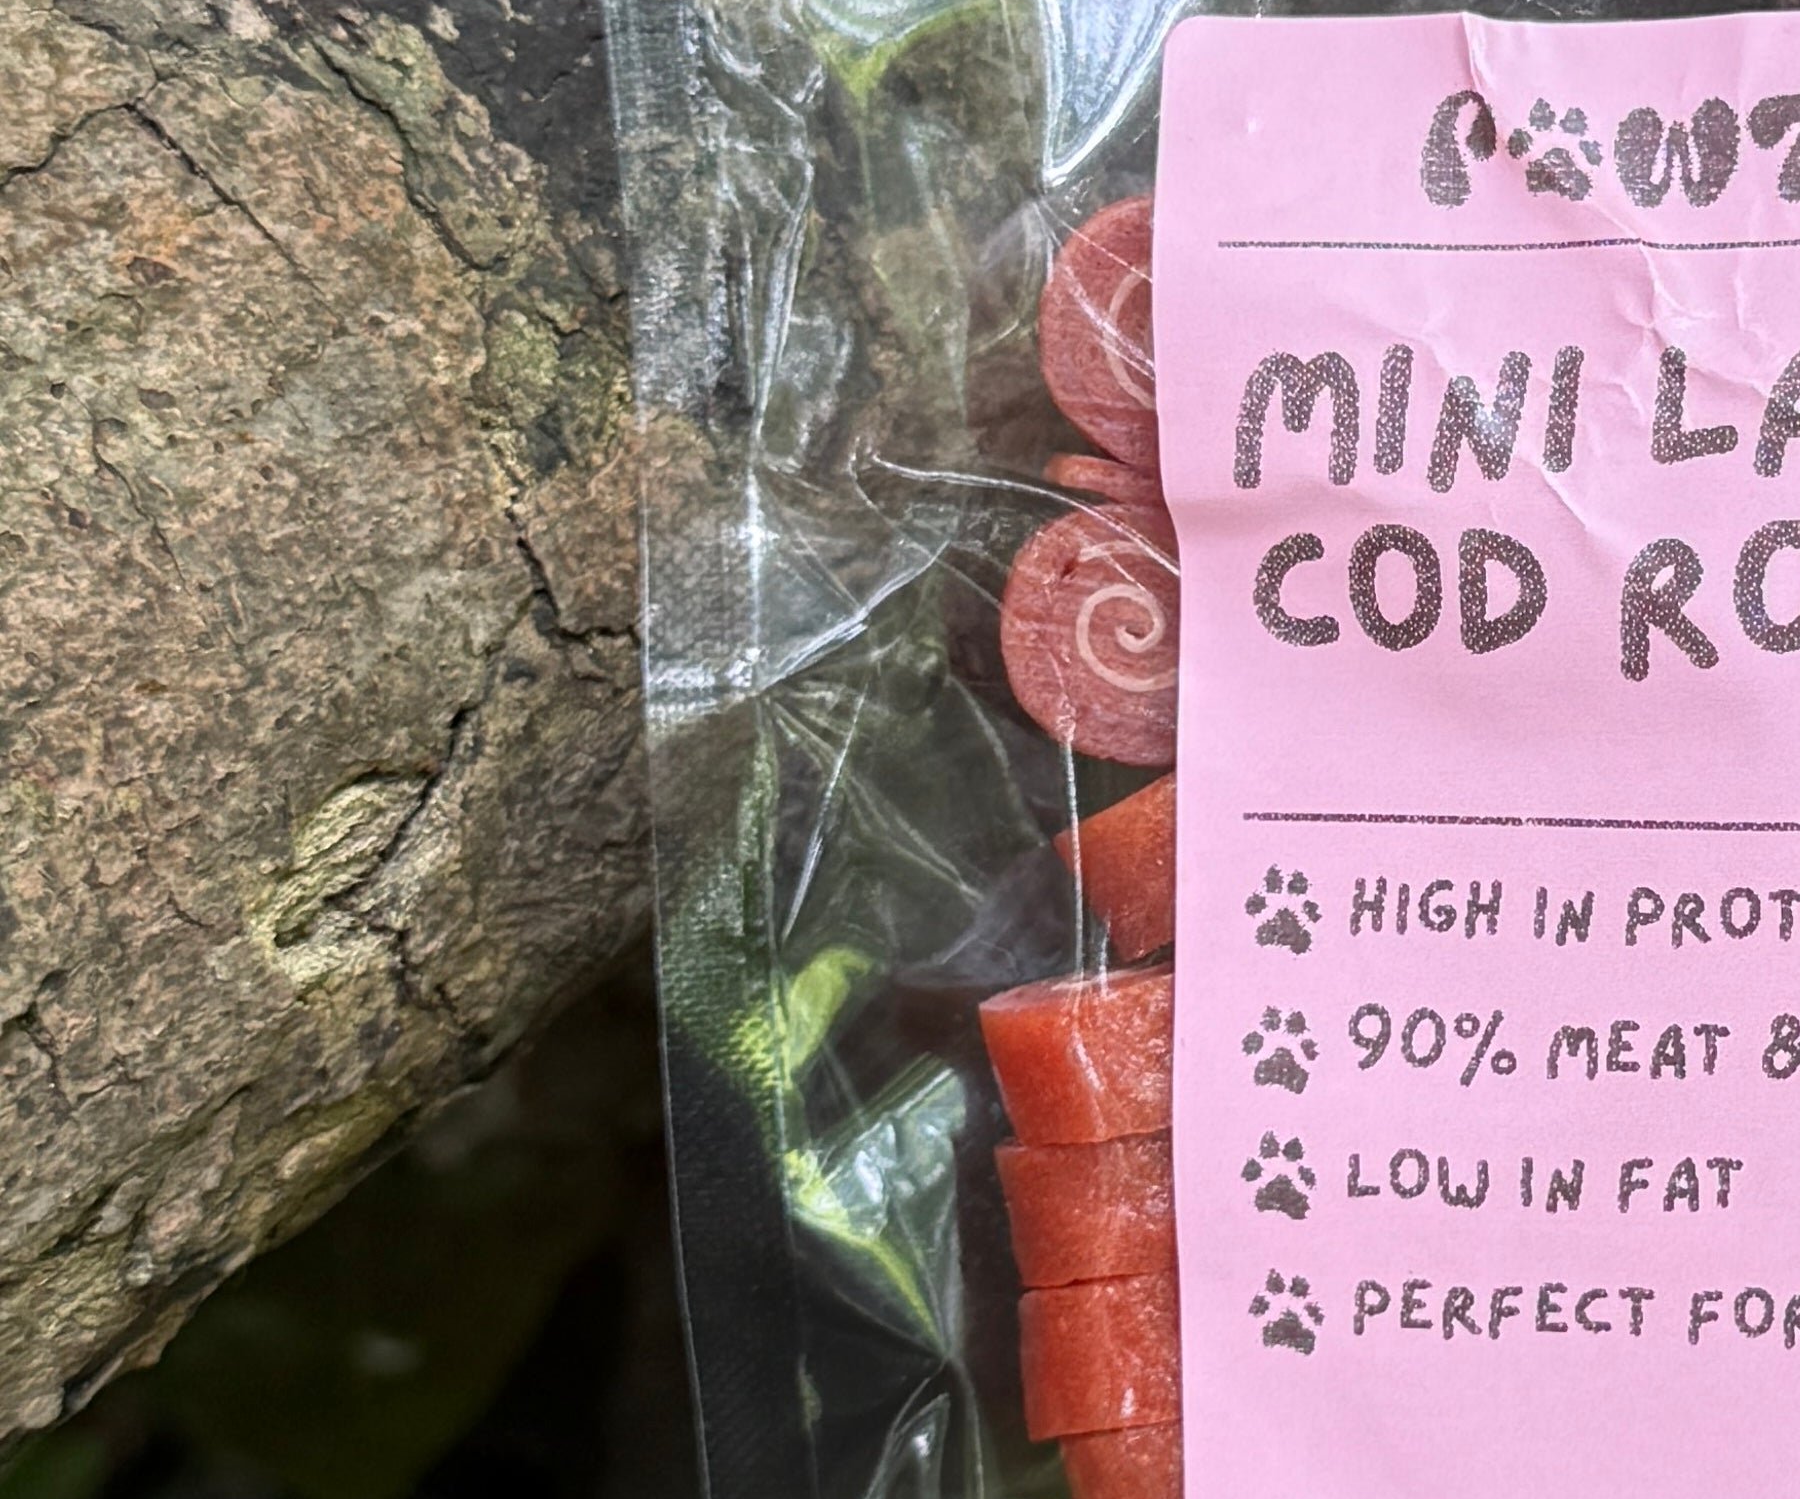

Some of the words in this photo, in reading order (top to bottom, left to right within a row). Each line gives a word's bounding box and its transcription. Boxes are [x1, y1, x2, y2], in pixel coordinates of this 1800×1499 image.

[1234, 344, 1585, 493] MINI
[1252, 522, 1549, 655] COD
[1349, 876, 1503, 940] HIGH
[1534, 887, 1596, 947] IN
[1349, 1003, 1517, 1088] 90%
[1547, 1020, 1731, 1082] MEAT
[1347, 1149, 1490, 1210] LOW
[1520, 1157, 1586, 1215] IN
[1618, 1157, 1744, 1214] FAT
[1354, 1280, 1656, 1341] PERFECT
